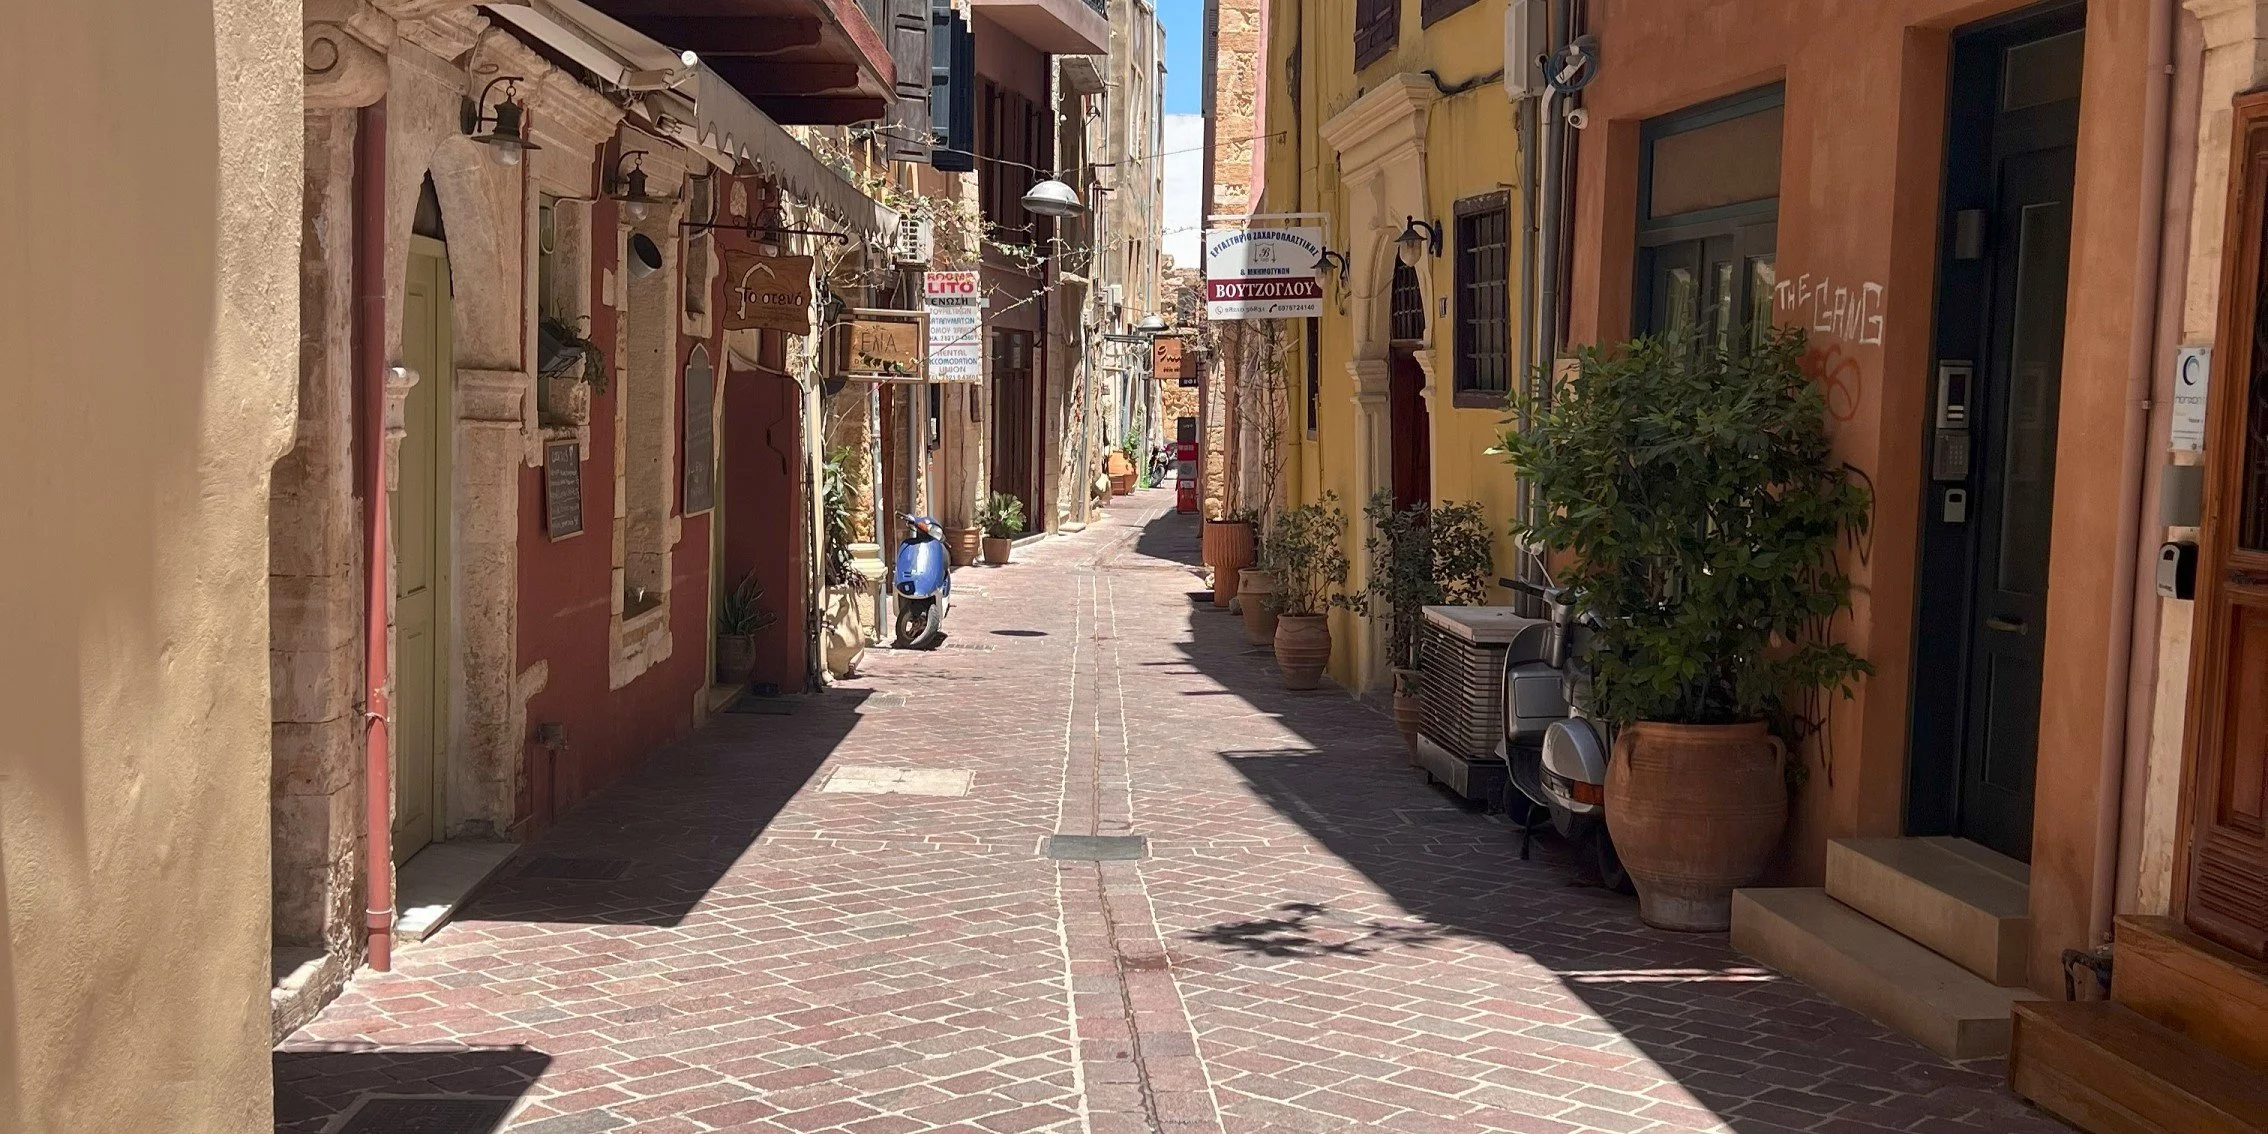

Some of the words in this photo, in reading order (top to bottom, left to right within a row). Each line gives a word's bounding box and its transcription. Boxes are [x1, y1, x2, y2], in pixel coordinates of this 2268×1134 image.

[928, 281, 974, 293] LITO
[1216, 282, 1314, 298] ΒΟΥΤΖΟΓΛΟΥ
[1775, 273, 1811, 310] THE
